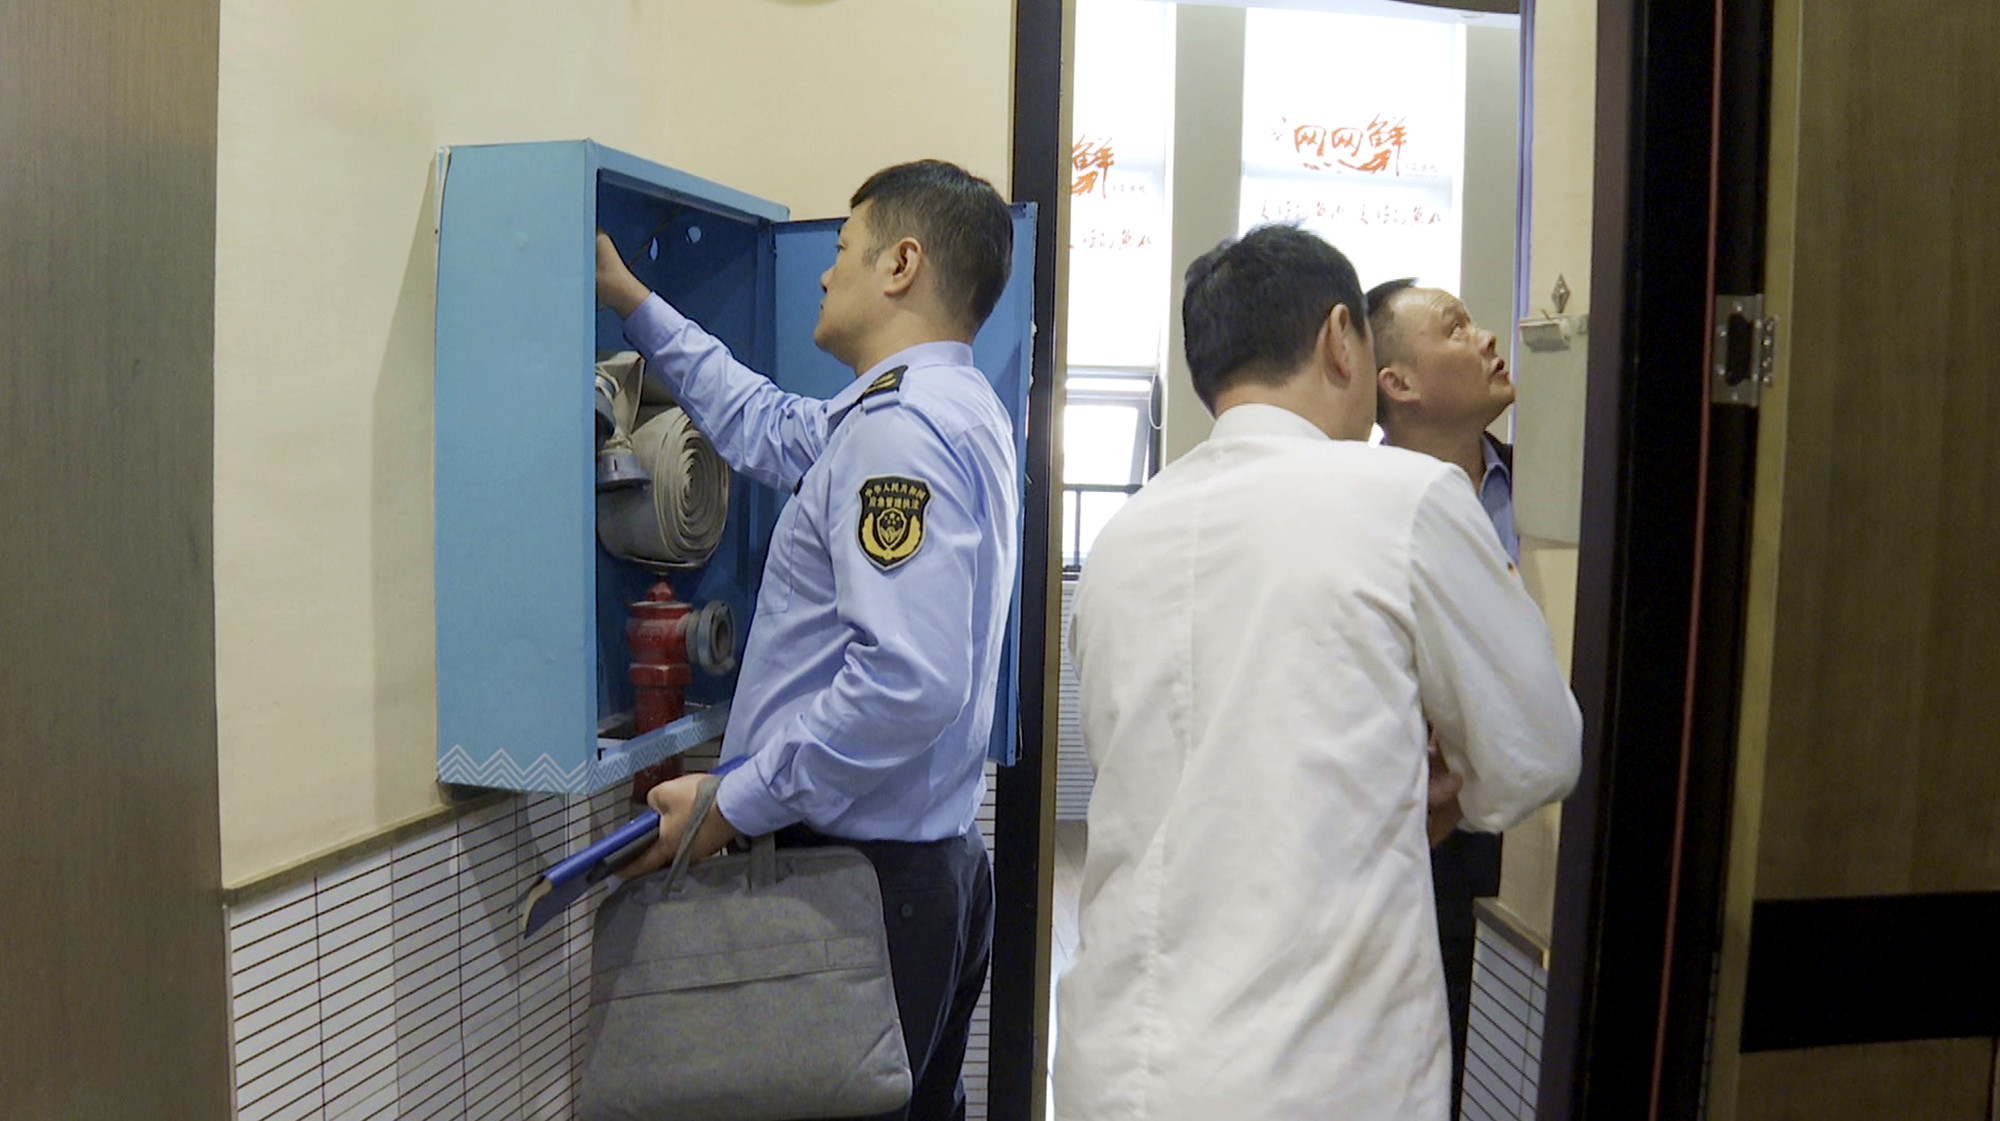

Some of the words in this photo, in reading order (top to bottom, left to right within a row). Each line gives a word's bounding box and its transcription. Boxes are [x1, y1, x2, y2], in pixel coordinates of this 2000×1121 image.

[865, 482, 926, 500] 中华人民共和国
[868, 496, 920, 510] 应急管理执法
